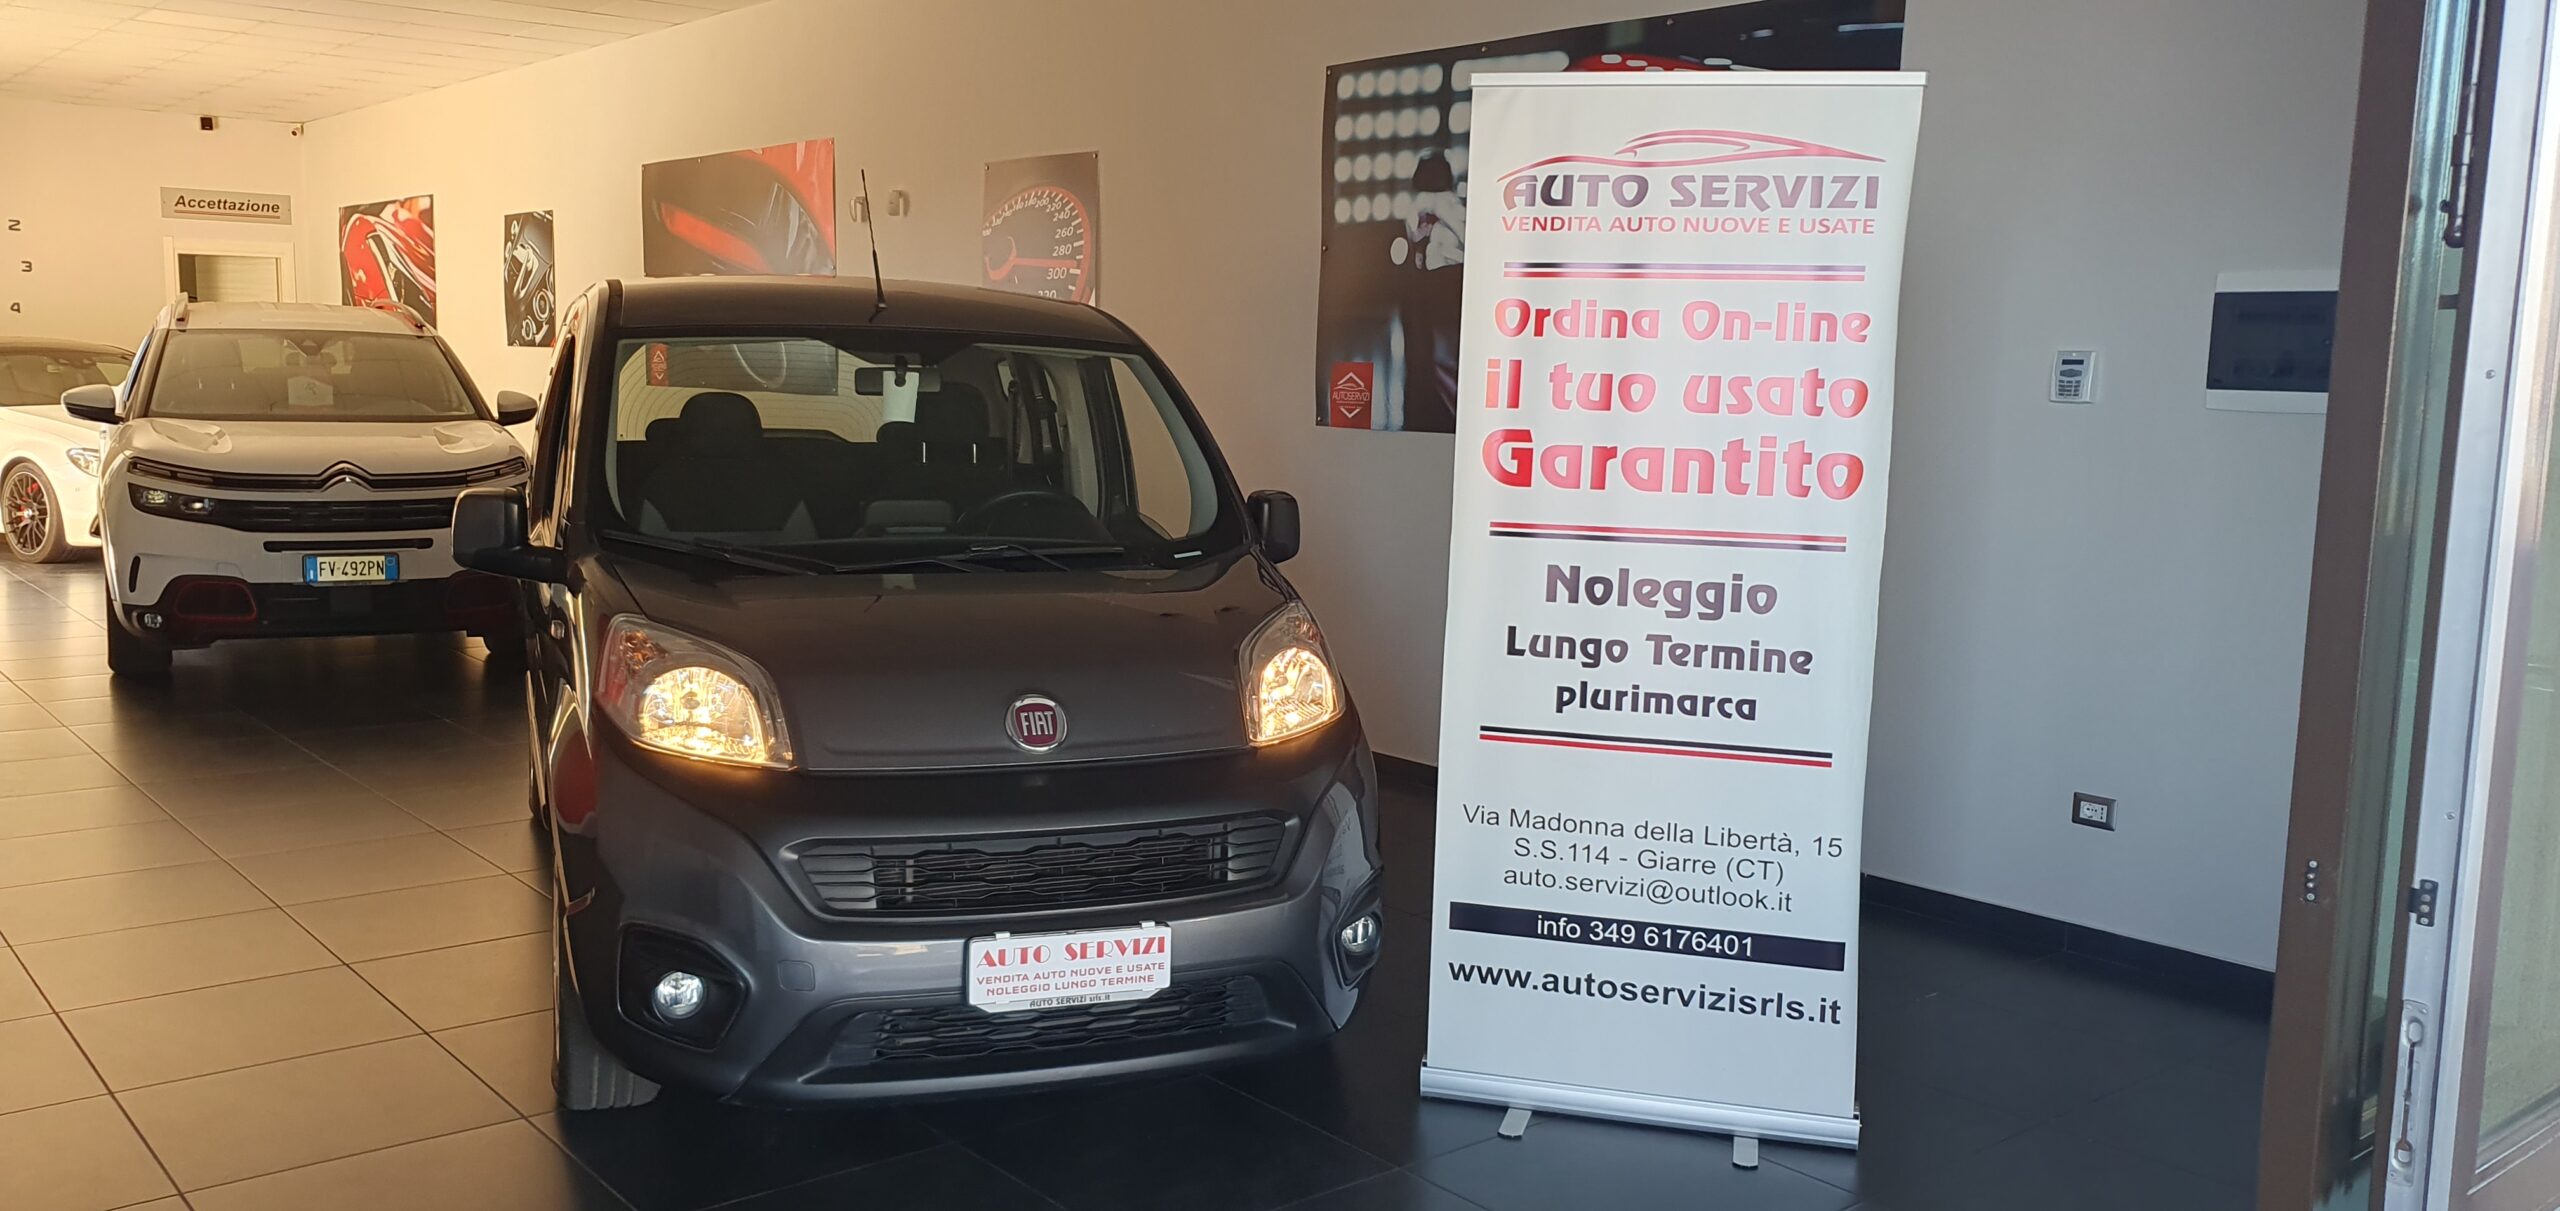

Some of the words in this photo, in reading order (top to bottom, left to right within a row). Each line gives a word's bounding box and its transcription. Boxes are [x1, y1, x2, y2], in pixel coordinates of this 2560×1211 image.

[174, 195, 280, 213] Accettazione
[1046, 202, 1061, 212] 220
[1502, 174, 1649, 211] AUTO
[1669, 175, 1880, 211] SERVIZI
[1053, 210, 1070, 221] 240
[1501, 215, 1601, 233] VENDITA
[1608, 216, 1676, 233] AUTO
[1682, 217, 1770, 234] NUOVE
[1778, 218, 1790, 234] E
[1799, 218, 1875, 235] USATE
[1055, 227, 1073, 238] 260
[21, 260, 32, 272] 3
[1052, 244, 1072, 256] 280
[1046, 267, 1067, 279] 300
[1494, 298, 1660, 339] Ordina
[1681, 300, 1871, 343] On-line
[1485, 358, 1522, 409] il
[1548, 362, 1657, 413] tuo
[1682, 368, 1869, 419] usato
[1481, 428, 1864, 501] Garantito
[1545, 563, 1778, 621] Noleggio
[1506, 625, 1629, 668] Lungo
[1645, 634, 1813, 675] Termine
[1555, 680, 1757, 721] plurimarca
[1020, 711, 1053, 736] FIAT
[1462, 803, 1500, 826] Via
[1509, 808, 1625, 838] Madonna
[1634, 820, 1694, 844] della
[1704, 825, 1800, 857] Libertà,
[1812, 836, 1843, 858] 15
[1514, 838, 1610, 866] S.S.114
[1637, 849, 1716, 875] Giarre
[1726, 856, 1784, 886] (CT)
[1503, 867, 1793, 913] auto.servizi@outlook.it
[976, 945, 1051, 968] AUTO
[1064, 936, 1166, 961] SERVIZI
[1537, 915, 1581, 939] info
[1589, 920, 1636, 944] 349
[1643, 925, 1753, 957] 6176401
[976, 973, 1029, 985] VENDITA
[1033, 970, 1066, 980] AUTO
[1070, 966, 1112, 977] NUOVE
[1116, 965, 1123, 973] E
[1127, 962, 1165, 972] USATE
[987, 983, 1050, 996] NOLEGGIO
[1055, 979, 1096, 991] LUNGO
[1102, 975, 1155, 986] TERMINE
[1030, 999, 1053, 1008] AUTO
[1056, 995, 1086, 1005] SERVIZI
[1449, 961, 1842, 1025] www.autoservizisrls.it
